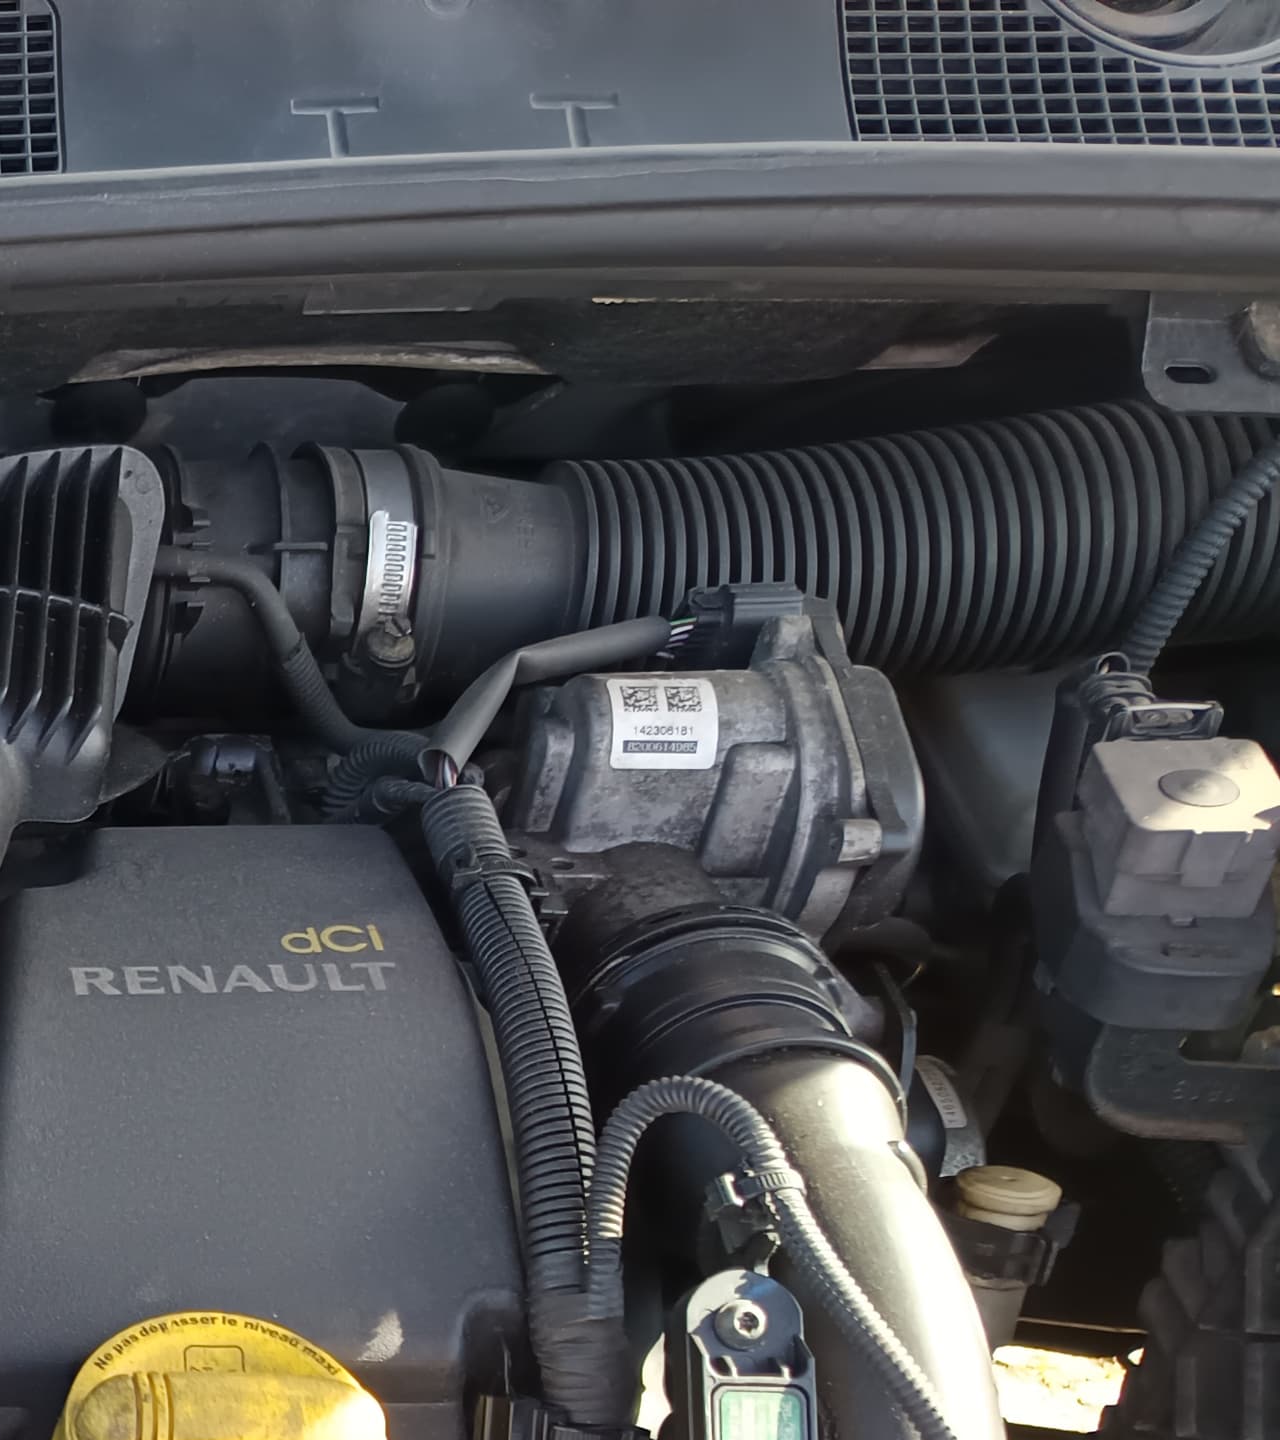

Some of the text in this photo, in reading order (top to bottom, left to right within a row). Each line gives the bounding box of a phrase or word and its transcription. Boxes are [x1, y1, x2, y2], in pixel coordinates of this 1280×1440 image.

[280, 923, 386, 955] dCi
[68, 961, 396, 996] RENAULT
[111, 1333, 140, 1356] pas
[221, 1315, 238, 1327] le
[301, 1345, 341, 1377] maxi
